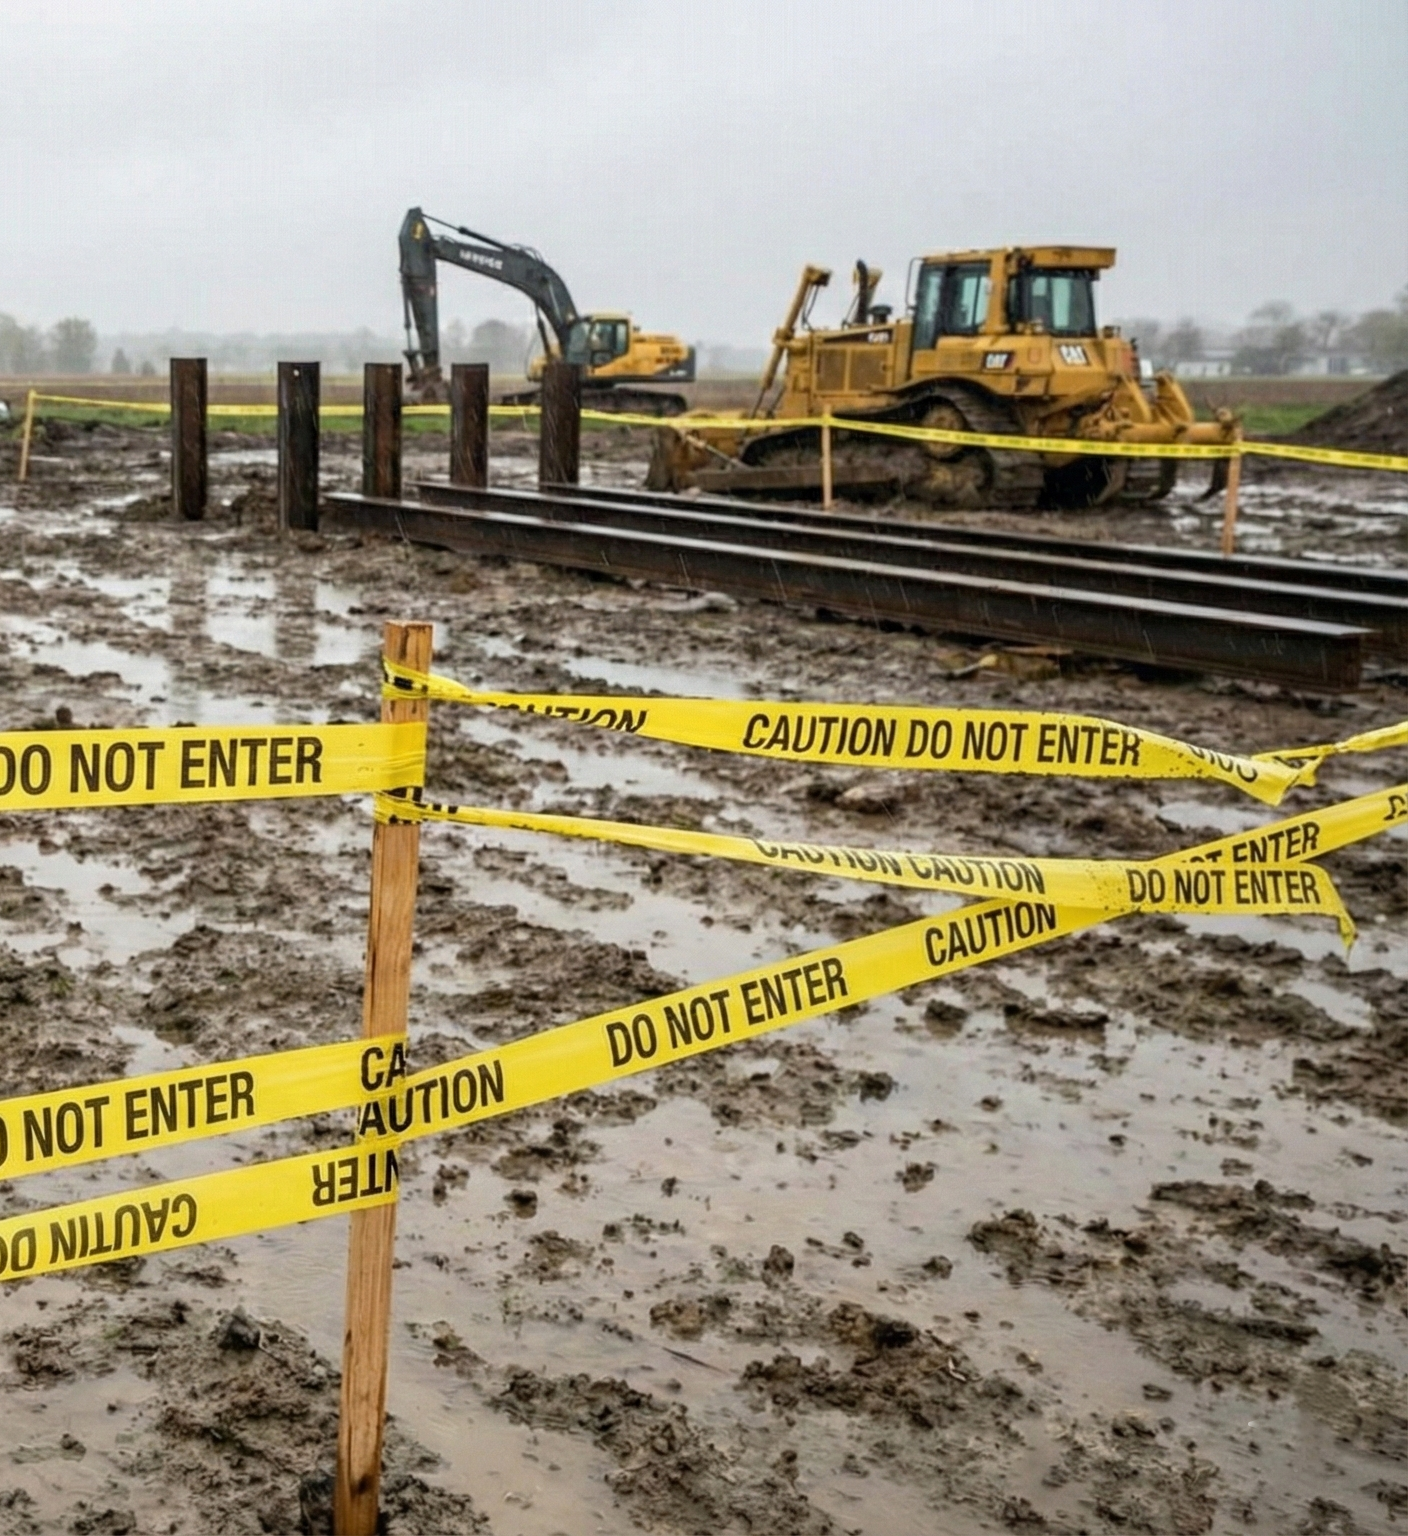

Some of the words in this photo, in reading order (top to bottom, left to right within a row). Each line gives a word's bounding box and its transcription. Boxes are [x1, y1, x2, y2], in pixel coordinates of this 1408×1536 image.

[70, 741, 165, 794] NOT
[180, 736, 323, 789] ENTER
[743, 713, 897, 757] CAUTION
[905, 718, 952, 759] DO
[962, 721, 1028, 762] NOT
[1037, 724, 1142, 766] ENTER
[908, 855, 1046, 894] CAUTION
[1127, 868, 1166, 904] DO
[1174, 869, 1225, 905] NOT
[1234, 869, 1321, 905] ENTER
[606, 1013, 657, 1068] DO
[664, 990, 730, 1049] NOT
[740, 957, 848, 1025] ENTER
[925, 903, 1057, 966] CAUTION
[24, 1096, 110, 1161] NOT
[125, 1071, 255, 1141] ENTER
[50, 1193, 198, 1264] CAUTIN
